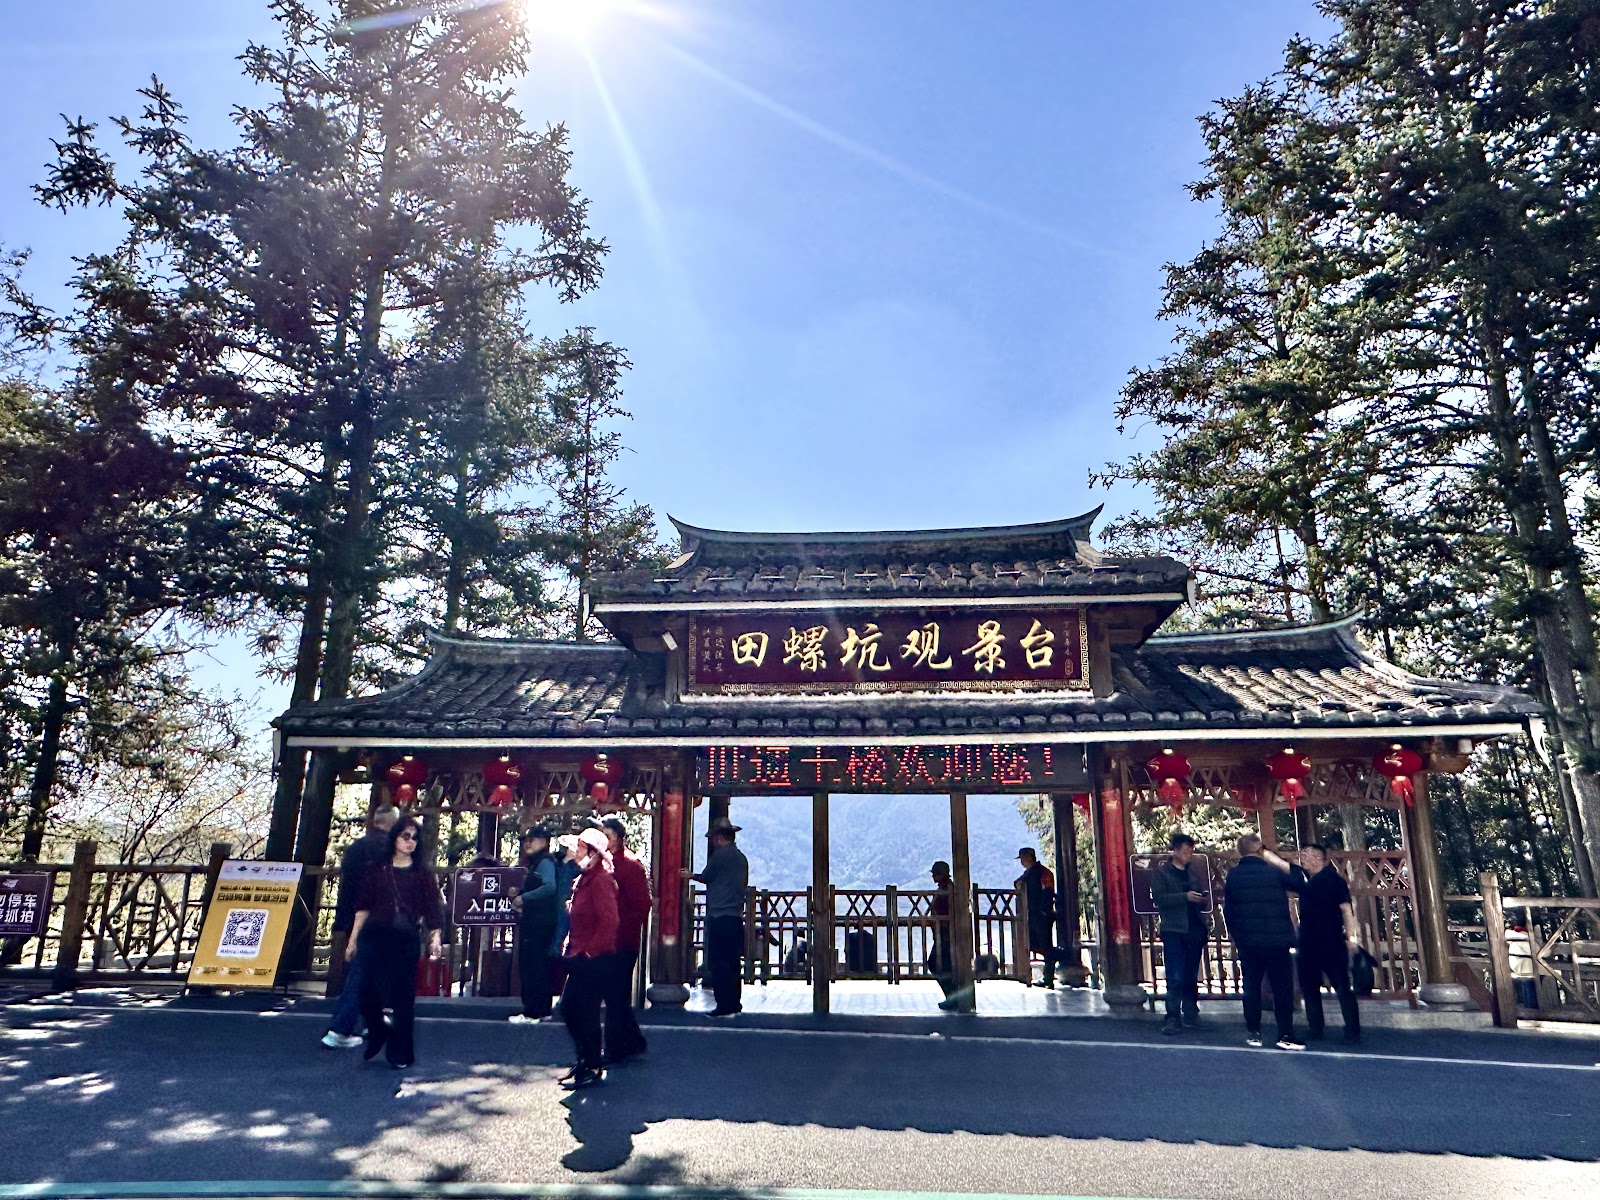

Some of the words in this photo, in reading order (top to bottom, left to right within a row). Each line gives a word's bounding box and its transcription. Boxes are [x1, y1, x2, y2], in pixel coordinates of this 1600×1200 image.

[731, 617, 1055, 674] 田螺坑观景台
[467, 897, 512, 913] 入口处
[0, 908, 34, 923] 抓拍
